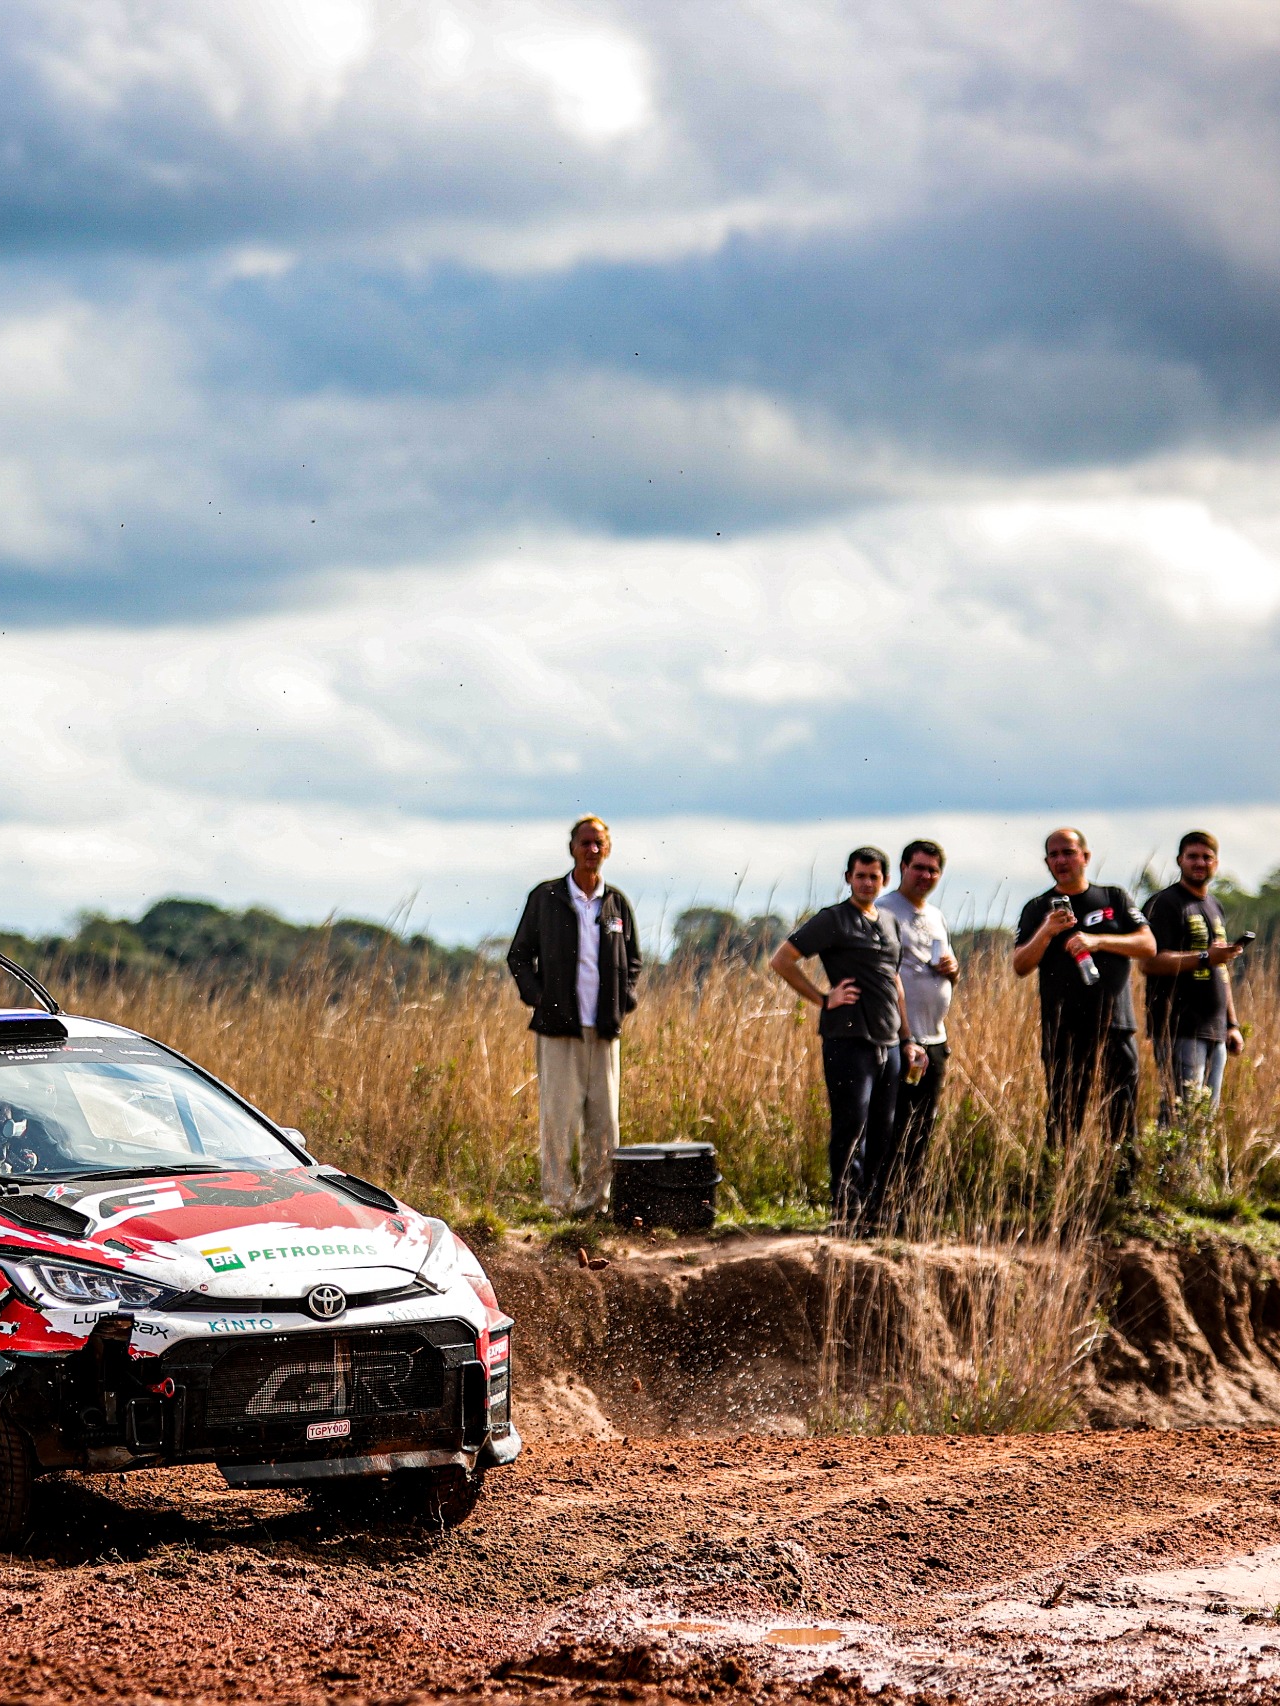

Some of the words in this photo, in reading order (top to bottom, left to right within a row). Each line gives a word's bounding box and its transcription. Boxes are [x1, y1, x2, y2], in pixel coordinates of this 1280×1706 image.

[1083, 907, 1114, 927] GR
[211, 1253, 238, 1267] BR
[247, 1244, 378, 1262] PETROBRAS
[310, 1425, 331, 1436] TGPY
[333, 1423, 348, 1433] 002
